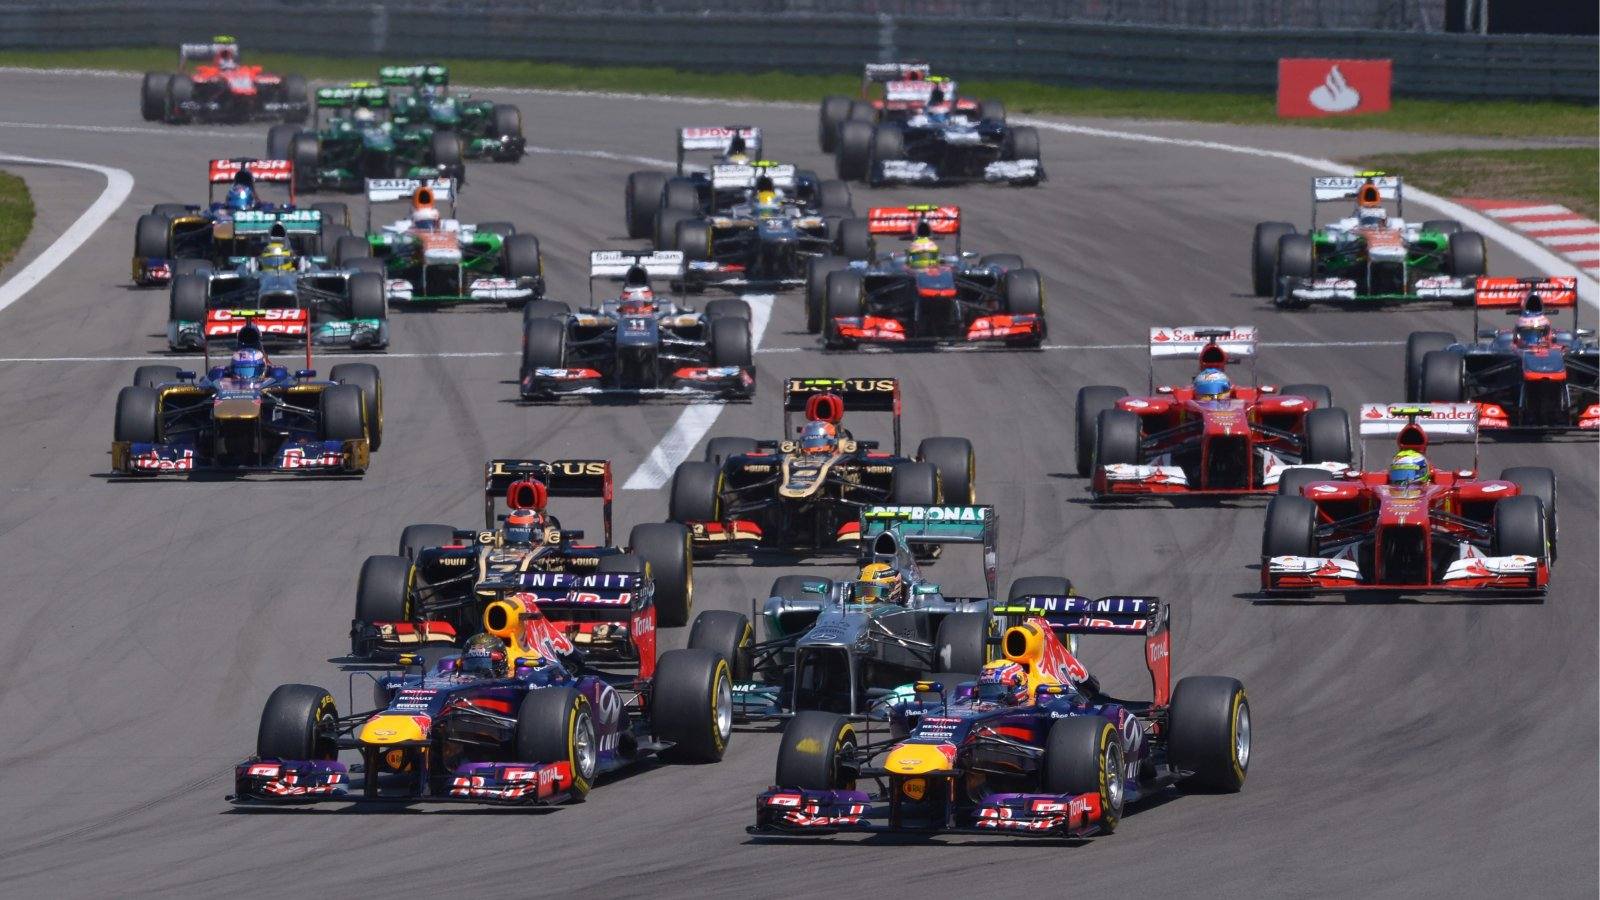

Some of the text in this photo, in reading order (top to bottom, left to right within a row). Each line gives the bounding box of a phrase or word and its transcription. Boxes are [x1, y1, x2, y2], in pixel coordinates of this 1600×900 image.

[1317, 177, 1387, 187] SAHAA
[214, 309, 300, 320] CSA
[1174, 325, 1252, 341] Sannder
[1387, 406, 1472, 420] Sander
[492, 462, 605, 475] LTUS
[539, 766, 564, 786] TOTAL
[1067, 797, 1093, 817] TOTAL
